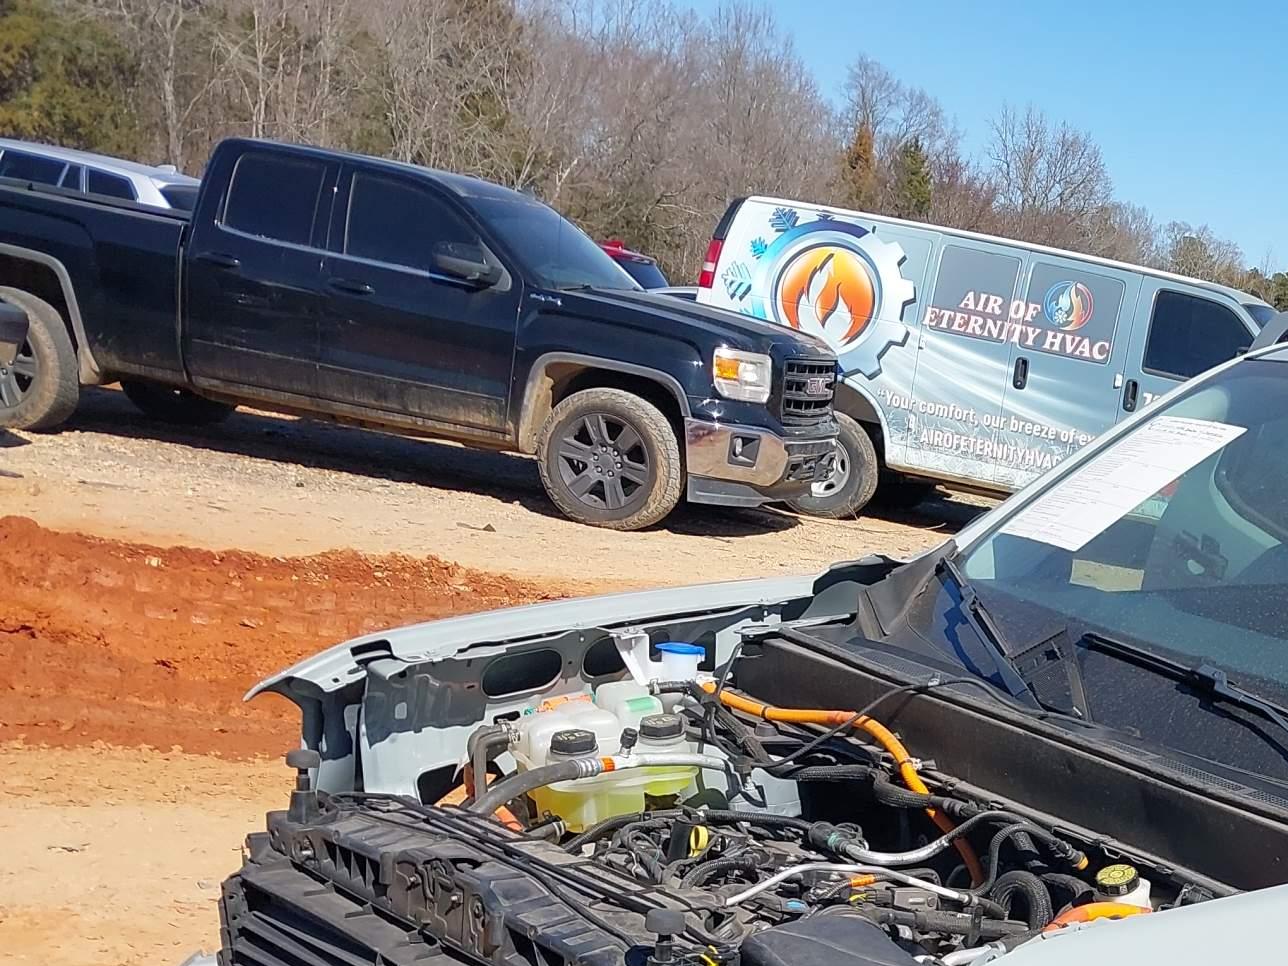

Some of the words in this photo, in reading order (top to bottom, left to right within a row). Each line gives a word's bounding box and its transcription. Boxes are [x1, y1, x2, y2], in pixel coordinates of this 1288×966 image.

[959, 290, 1004, 315] AIR
[1009, 300, 1041, 322] OF
[922, 306, 1042, 345] ETERNITY
[1042, 330, 1110, 360] HVAC
[807, 377, 834, 398] GMC
[919, 400, 977, 427] comfort,
[984, 413, 1006, 430] our
[1010, 416, 1057, 440] breeze
[1060, 428, 1076, 444] of
